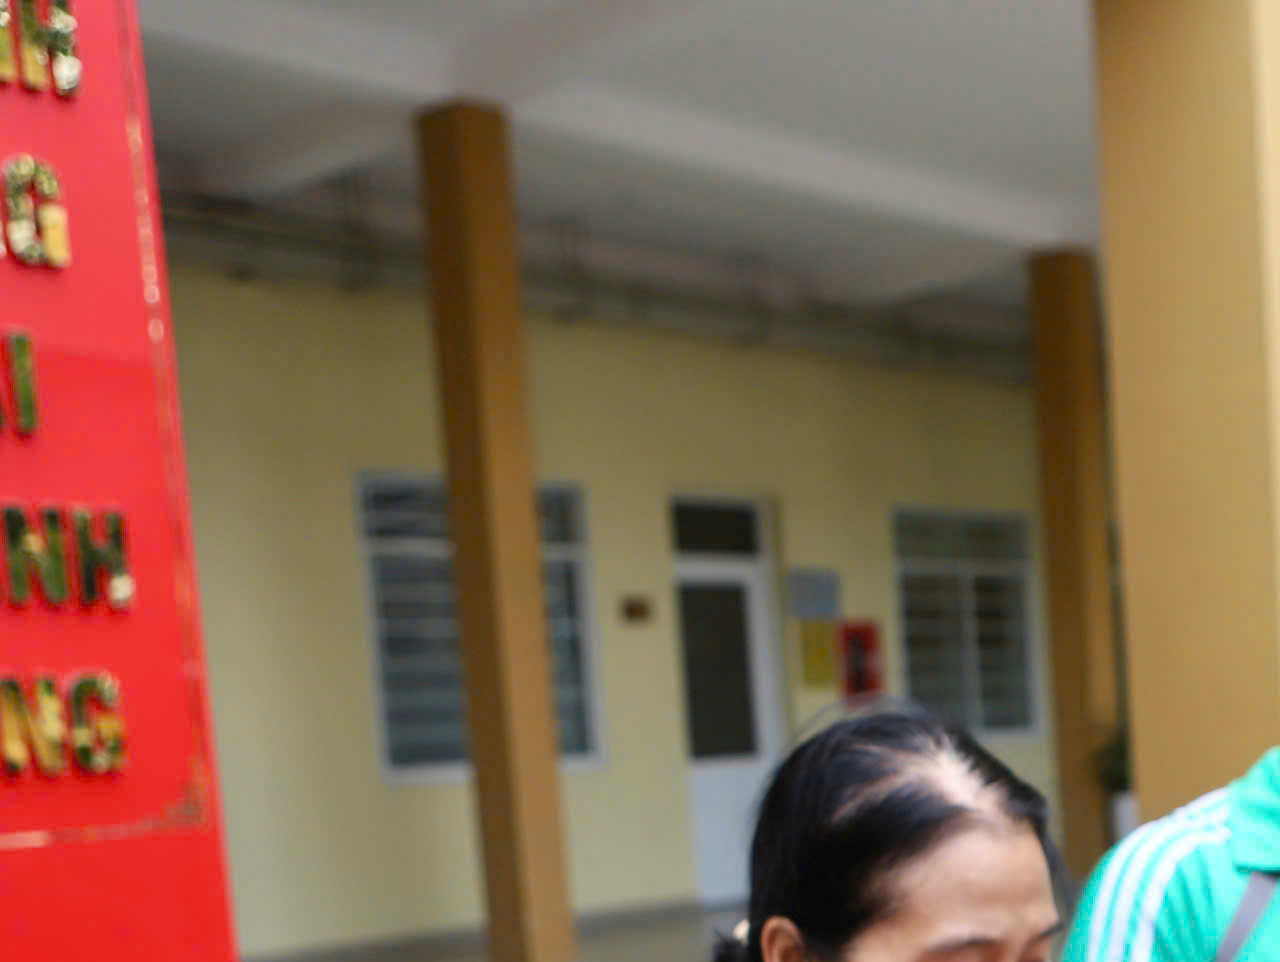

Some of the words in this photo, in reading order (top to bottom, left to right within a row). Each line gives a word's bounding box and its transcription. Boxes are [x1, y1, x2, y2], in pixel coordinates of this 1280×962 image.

[0, 0, 82, 96] H
[0, 153, 71, 268] G
[0, 333, 38, 434] I
[4, 504, 135, 606] NH
[0, 673, 125, 774] NG
